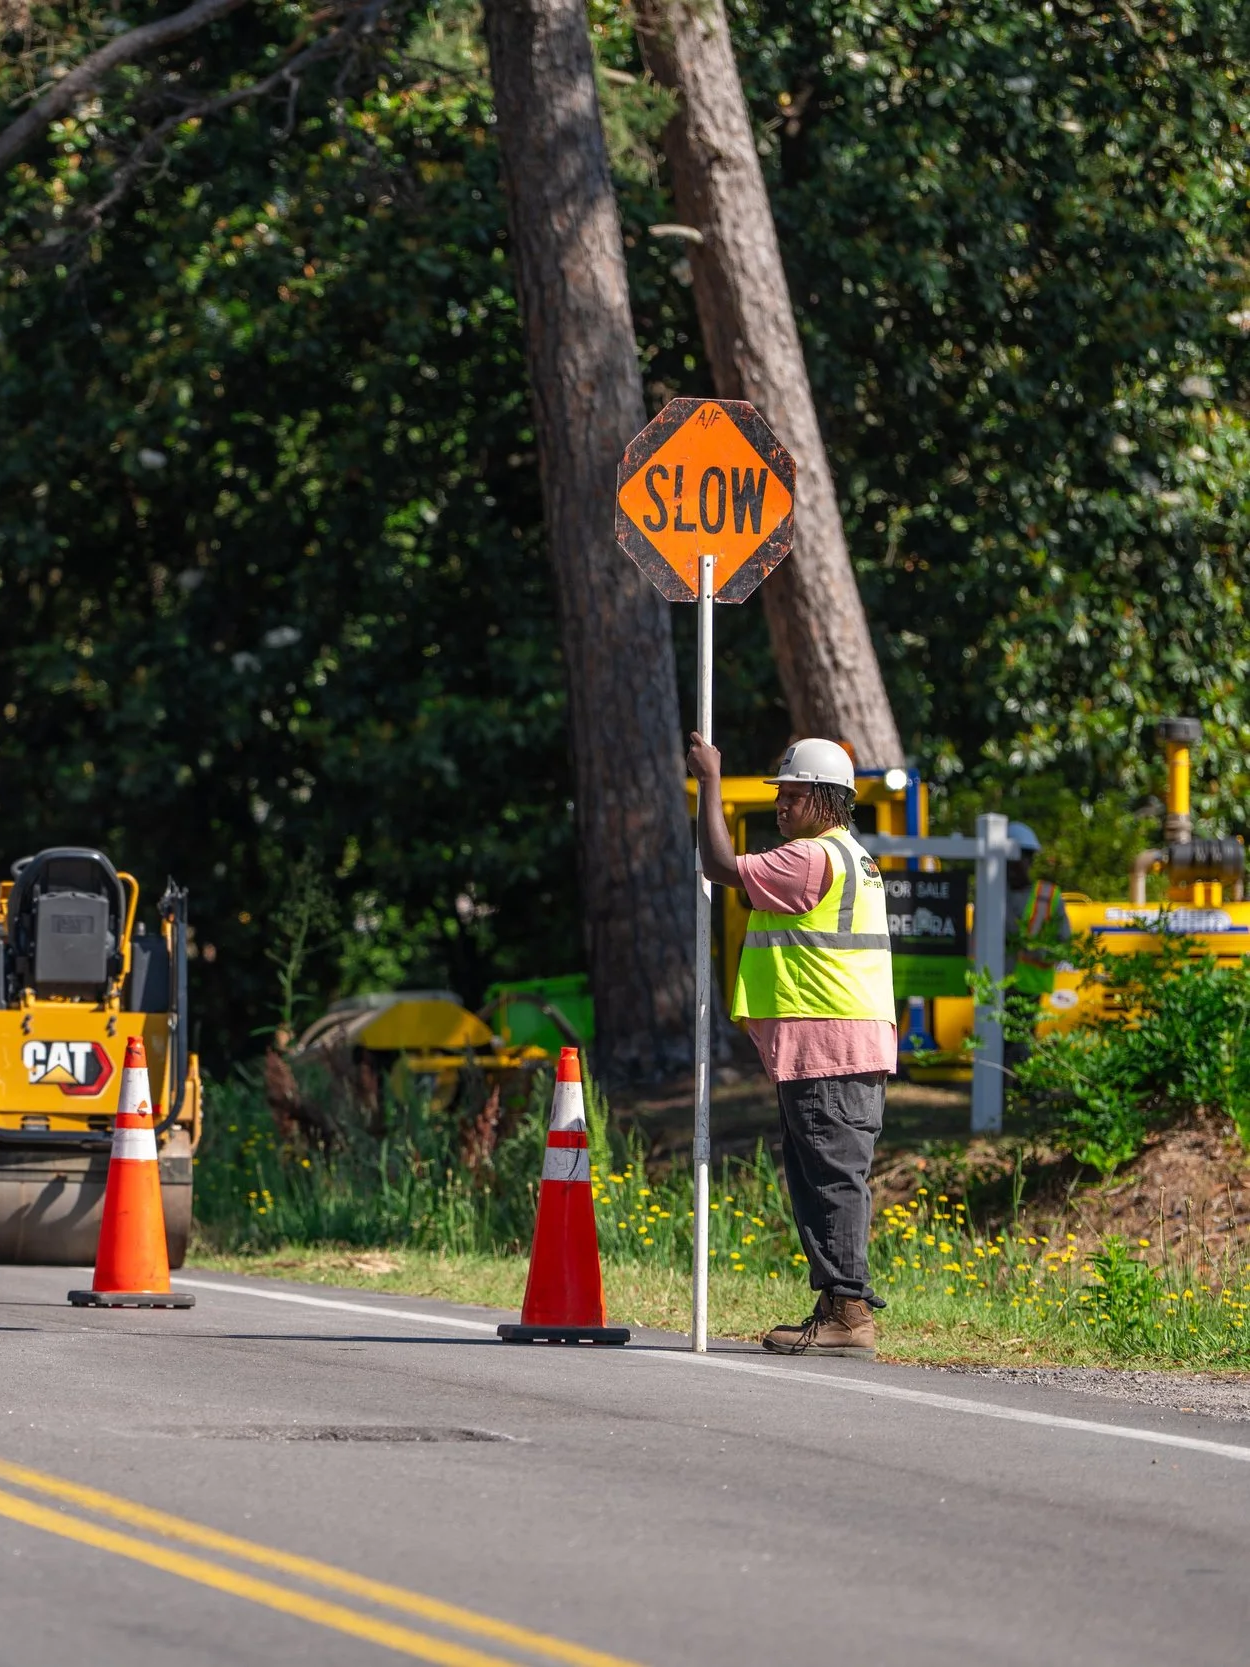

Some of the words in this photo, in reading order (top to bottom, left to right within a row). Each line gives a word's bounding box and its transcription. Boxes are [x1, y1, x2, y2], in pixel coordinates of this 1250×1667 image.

[642, 464, 769, 534] SLOW
[884, 880, 912, 898] FOR
[915, 881, 951, 899] SALE
[22, 1040, 93, 1084] CAT
